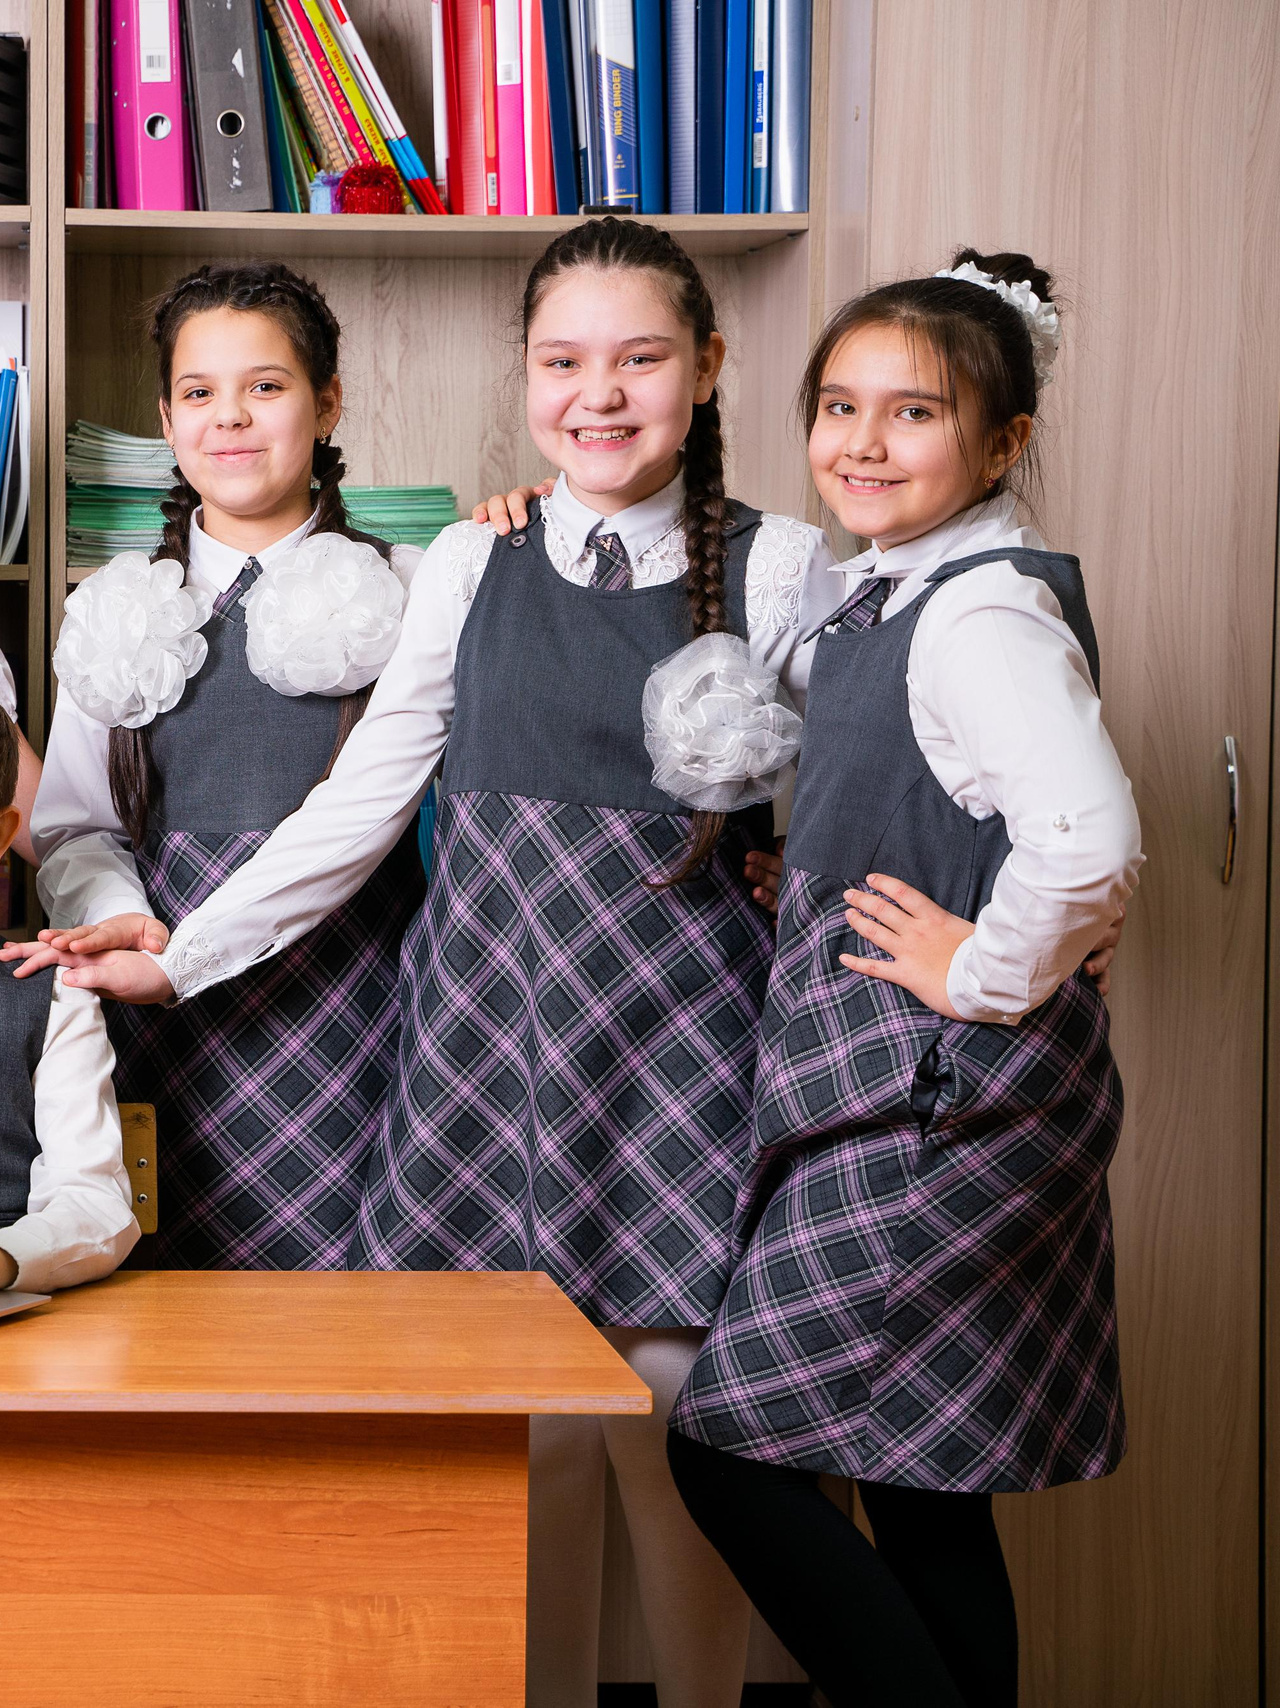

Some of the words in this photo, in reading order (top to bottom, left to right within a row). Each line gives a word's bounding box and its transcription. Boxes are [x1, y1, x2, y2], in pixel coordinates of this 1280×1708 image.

[318, 21, 334, 48] СКАЗОК
[331, 48, 347, 75] СТРАНЕ
[612, 68, 622, 108] BINDER
[614, 109, 623, 136] RING
